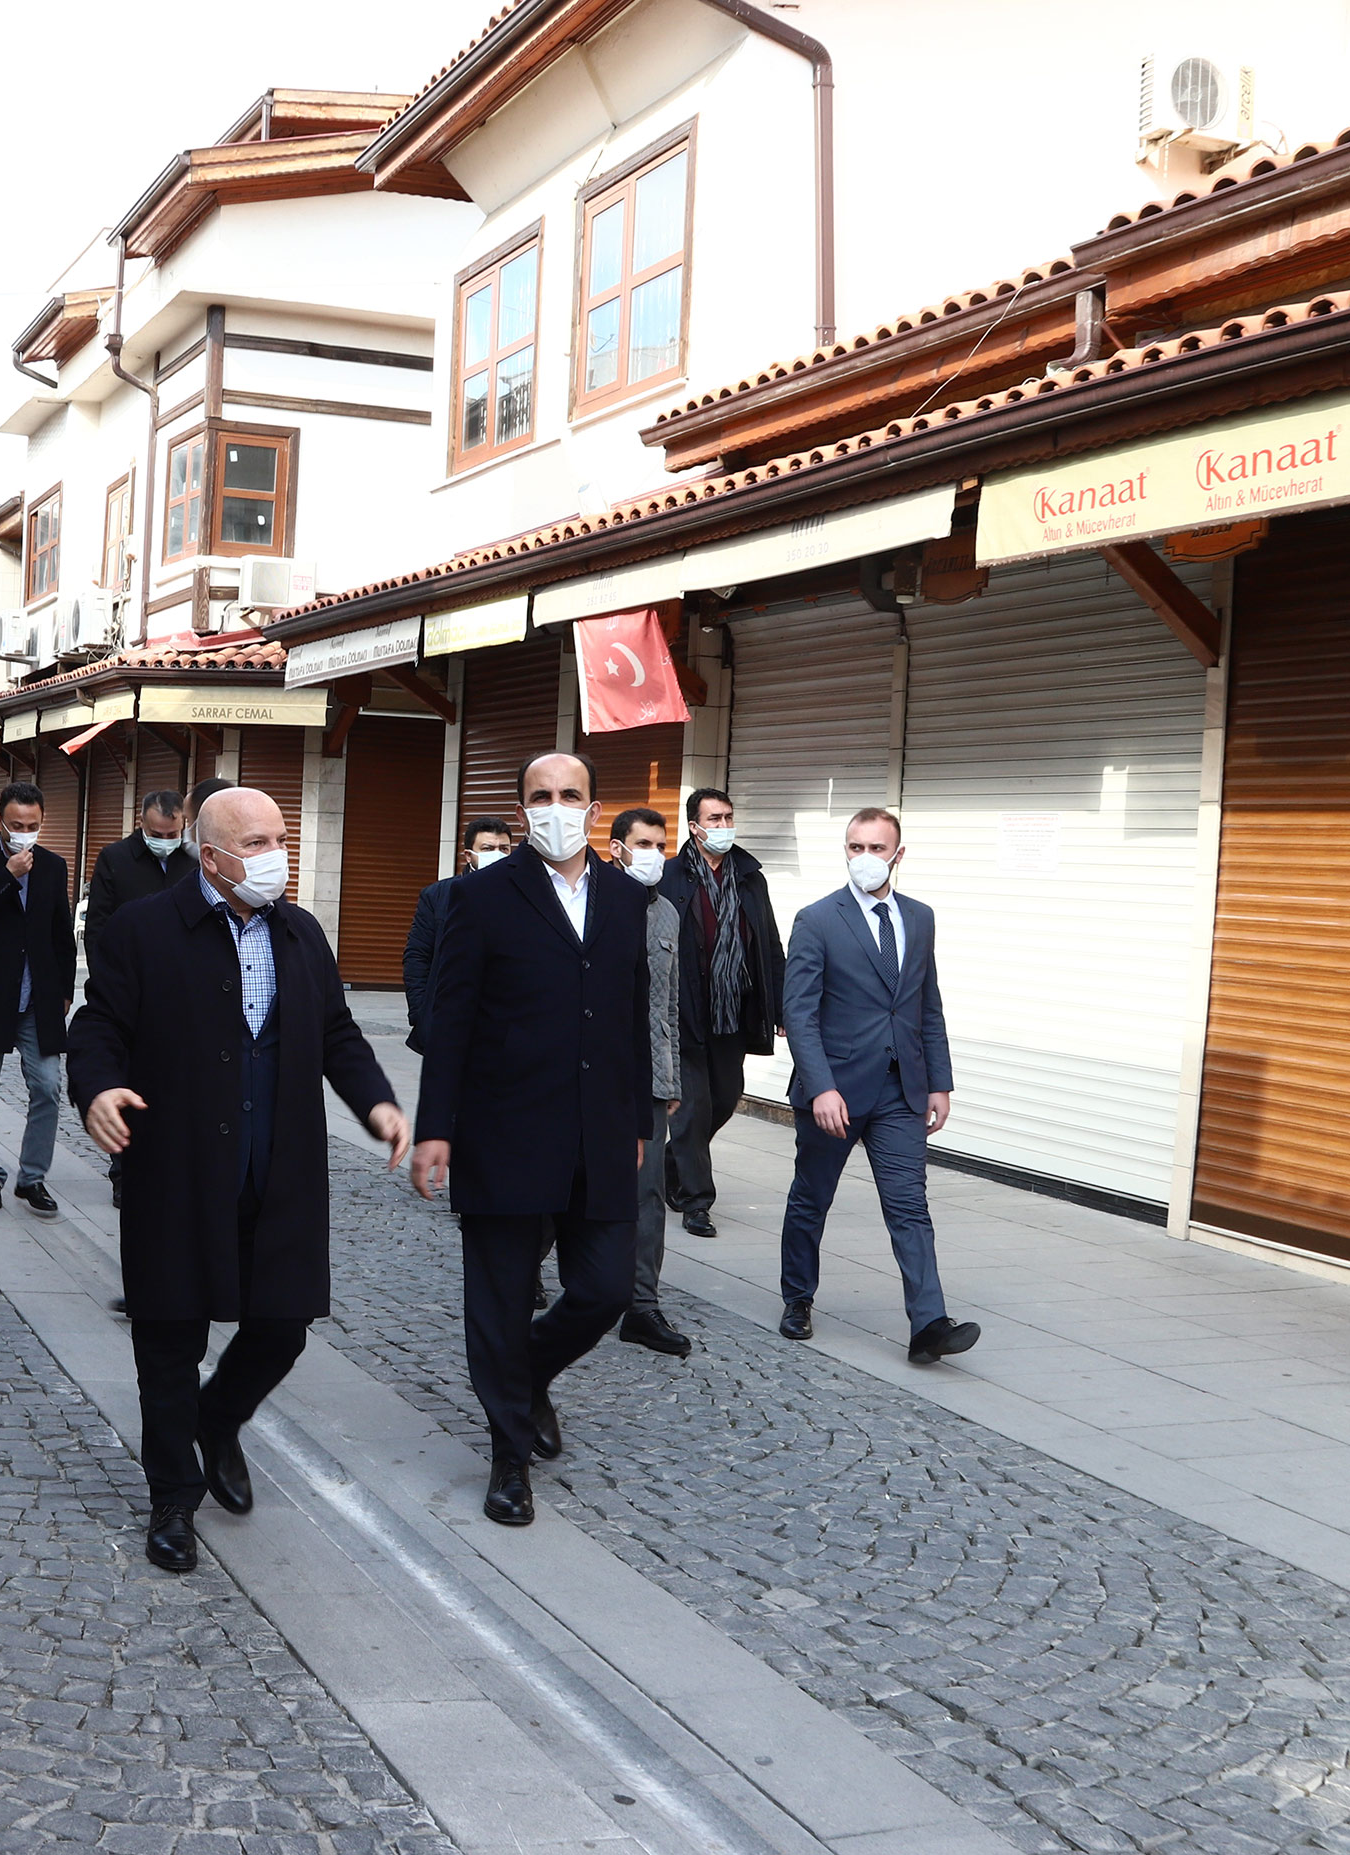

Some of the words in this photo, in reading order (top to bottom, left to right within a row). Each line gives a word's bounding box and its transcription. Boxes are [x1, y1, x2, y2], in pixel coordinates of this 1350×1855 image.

[1196, 430, 1338, 491] Kanaat
[1034, 470, 1148, 524] Kanaat
[1236, 490, 1246, 507] &
[1249, 476, 1324, 503] Mücevherat
[1065, 523, 1075, 538] &
[1076, 512, 1137, 535] Mücevherat
[191, 706, 233, 719] SARRAF
[235, 707, 274, 720] CEMAL
